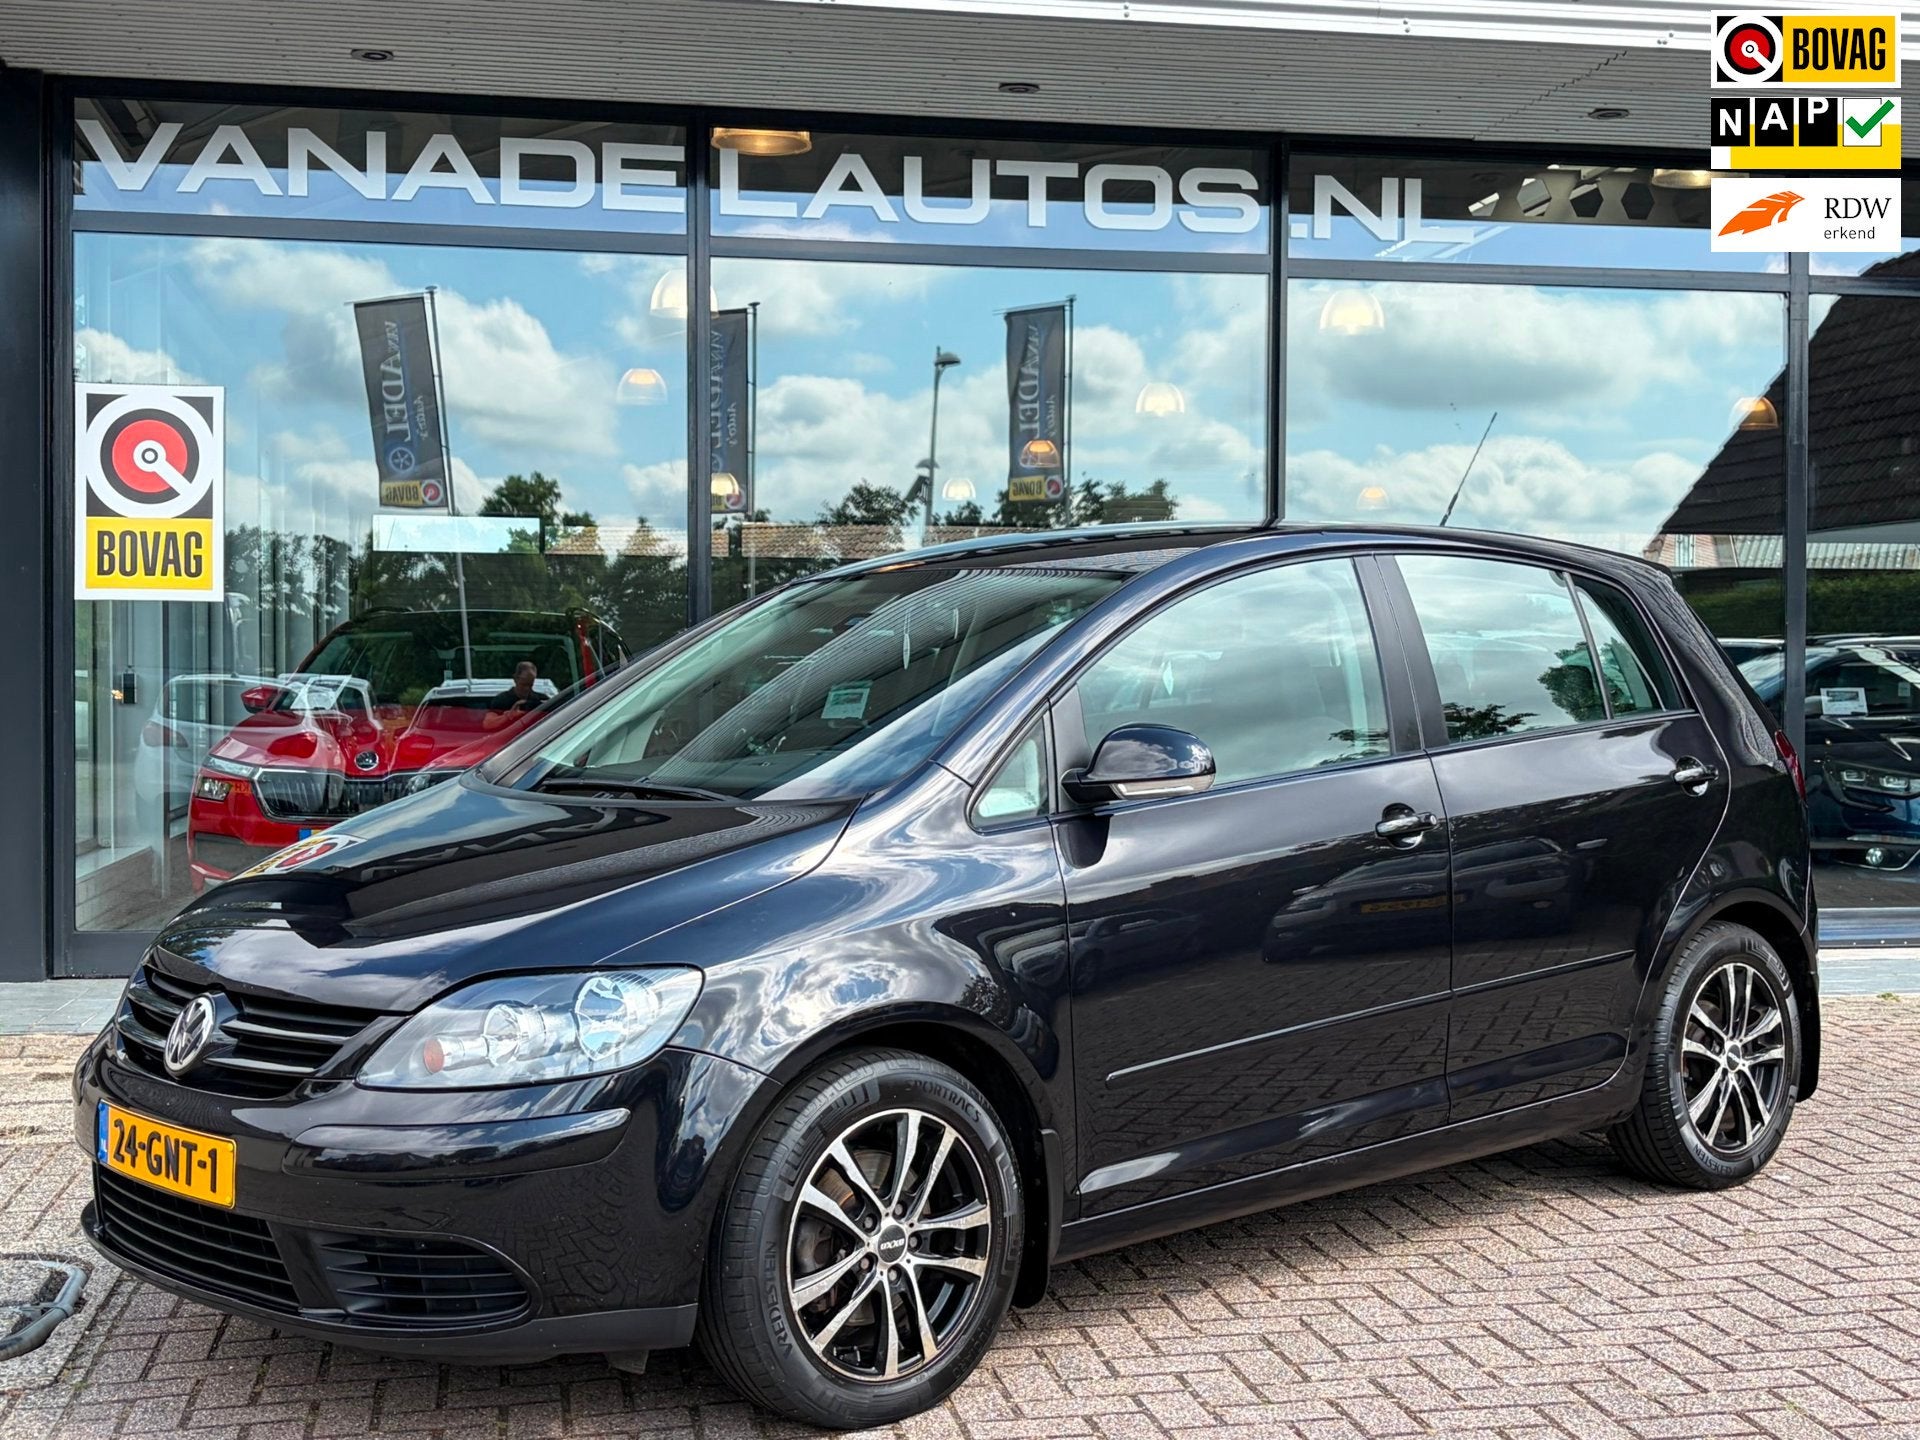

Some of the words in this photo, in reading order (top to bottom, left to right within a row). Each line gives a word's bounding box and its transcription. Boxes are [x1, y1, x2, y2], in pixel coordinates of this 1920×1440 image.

[97, 530, 202, 578] BOVAG
[113, 1118, 217, 1194] 24-GNT-1
[763, 1240, 793, 1360] VREDESTEIN
